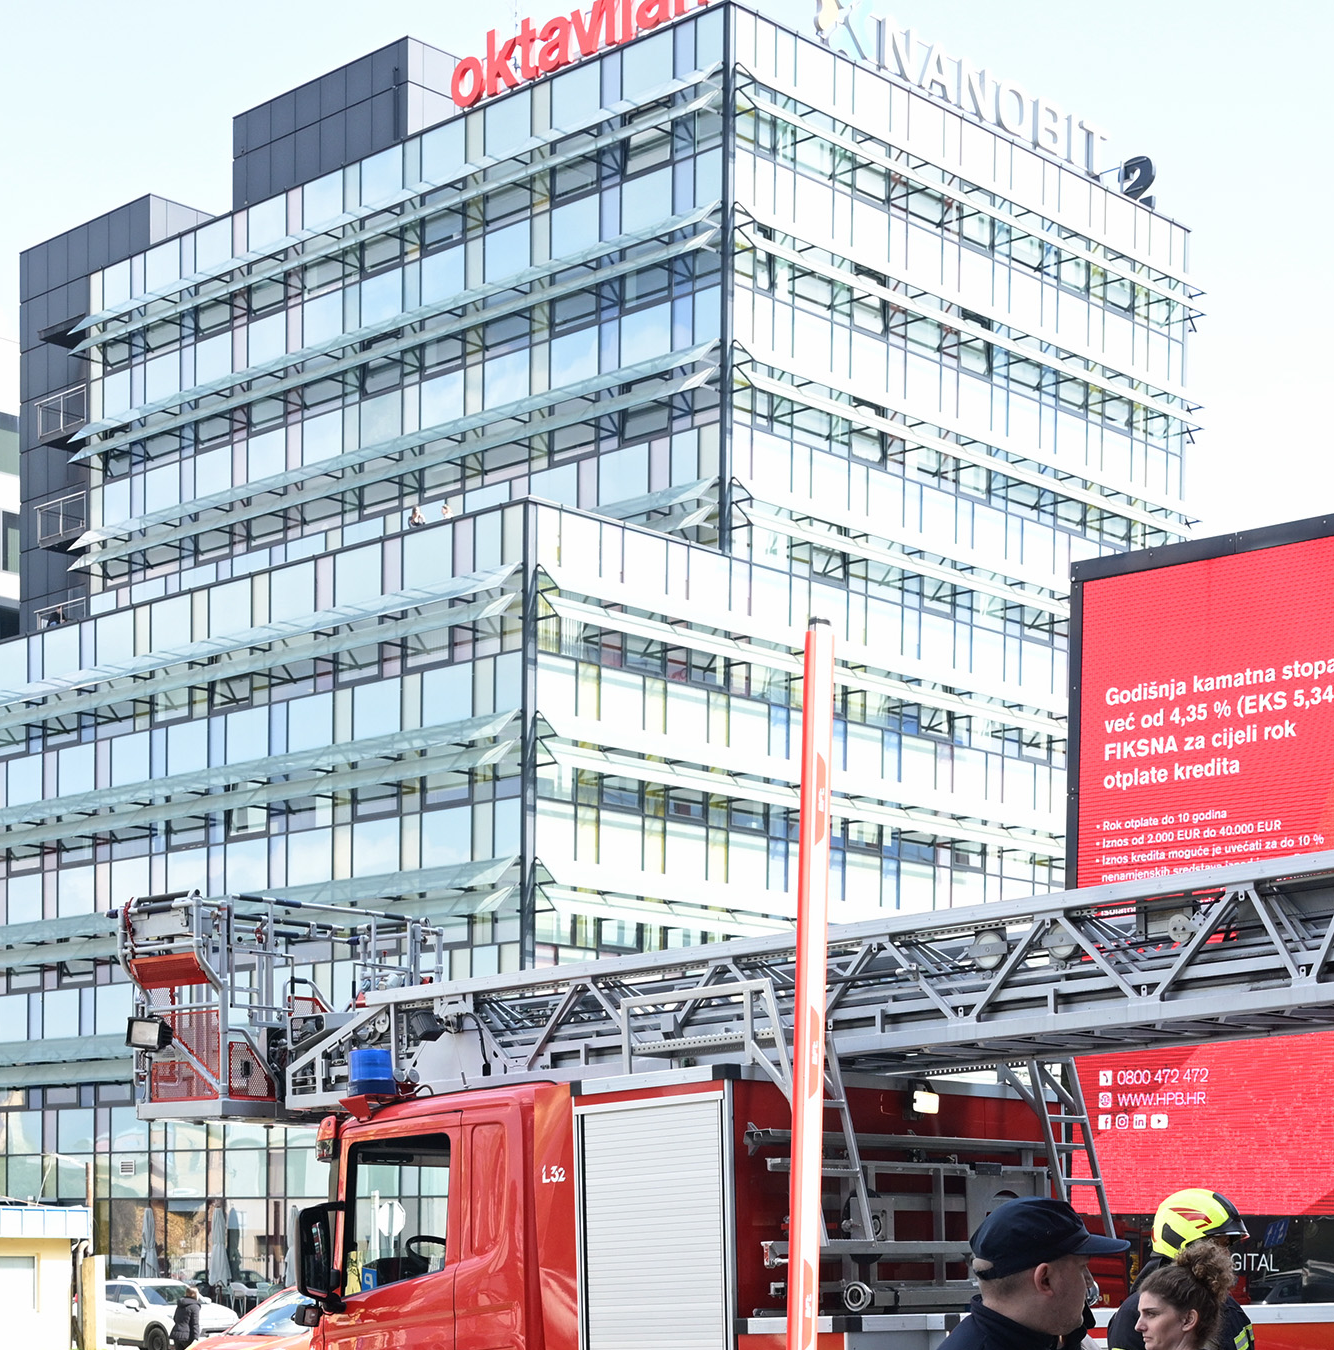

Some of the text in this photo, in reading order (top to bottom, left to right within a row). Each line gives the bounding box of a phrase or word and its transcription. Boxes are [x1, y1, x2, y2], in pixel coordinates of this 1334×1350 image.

[870, 15, 1109, 180] NANOBIT
[1118, 155, 1156, 211] 2
[1106, 678, 1185, 705] Godišnja
[1193, 666, 1276, 692] kamatna
[1105, 712, 1135, 733] već
[1141, 707, 1164, 728] od
[1170, 703, 1207, 726] 4,35
[1214, 700, 1231, 718] %
[1237, 691, 1287, 718] (EKS
[1293, 685, 1334, 710] 5,34
[1105, 720, 1296, 761] FIKSNA za cijeli rok
[1104, 758, 1239, 790] otplate kredita
[1102, 820, 1281, 849] Iznos od 2.000 EUR do 40.000 EUR
[1103, 809, 1227, 831] Rok otplate do 10 godina
[1102, 834, 1324, 865] Iznos kredita moguće je uvećati za do 10 %
[1117, 1068, 1209, 1085] 0800 472 472
[1117, 1092, 1206, 1106] WWW.HPB.HR
[541, 1164, 566, 1184] L32
[1231, 1253, 1280, 1272] GITAL
